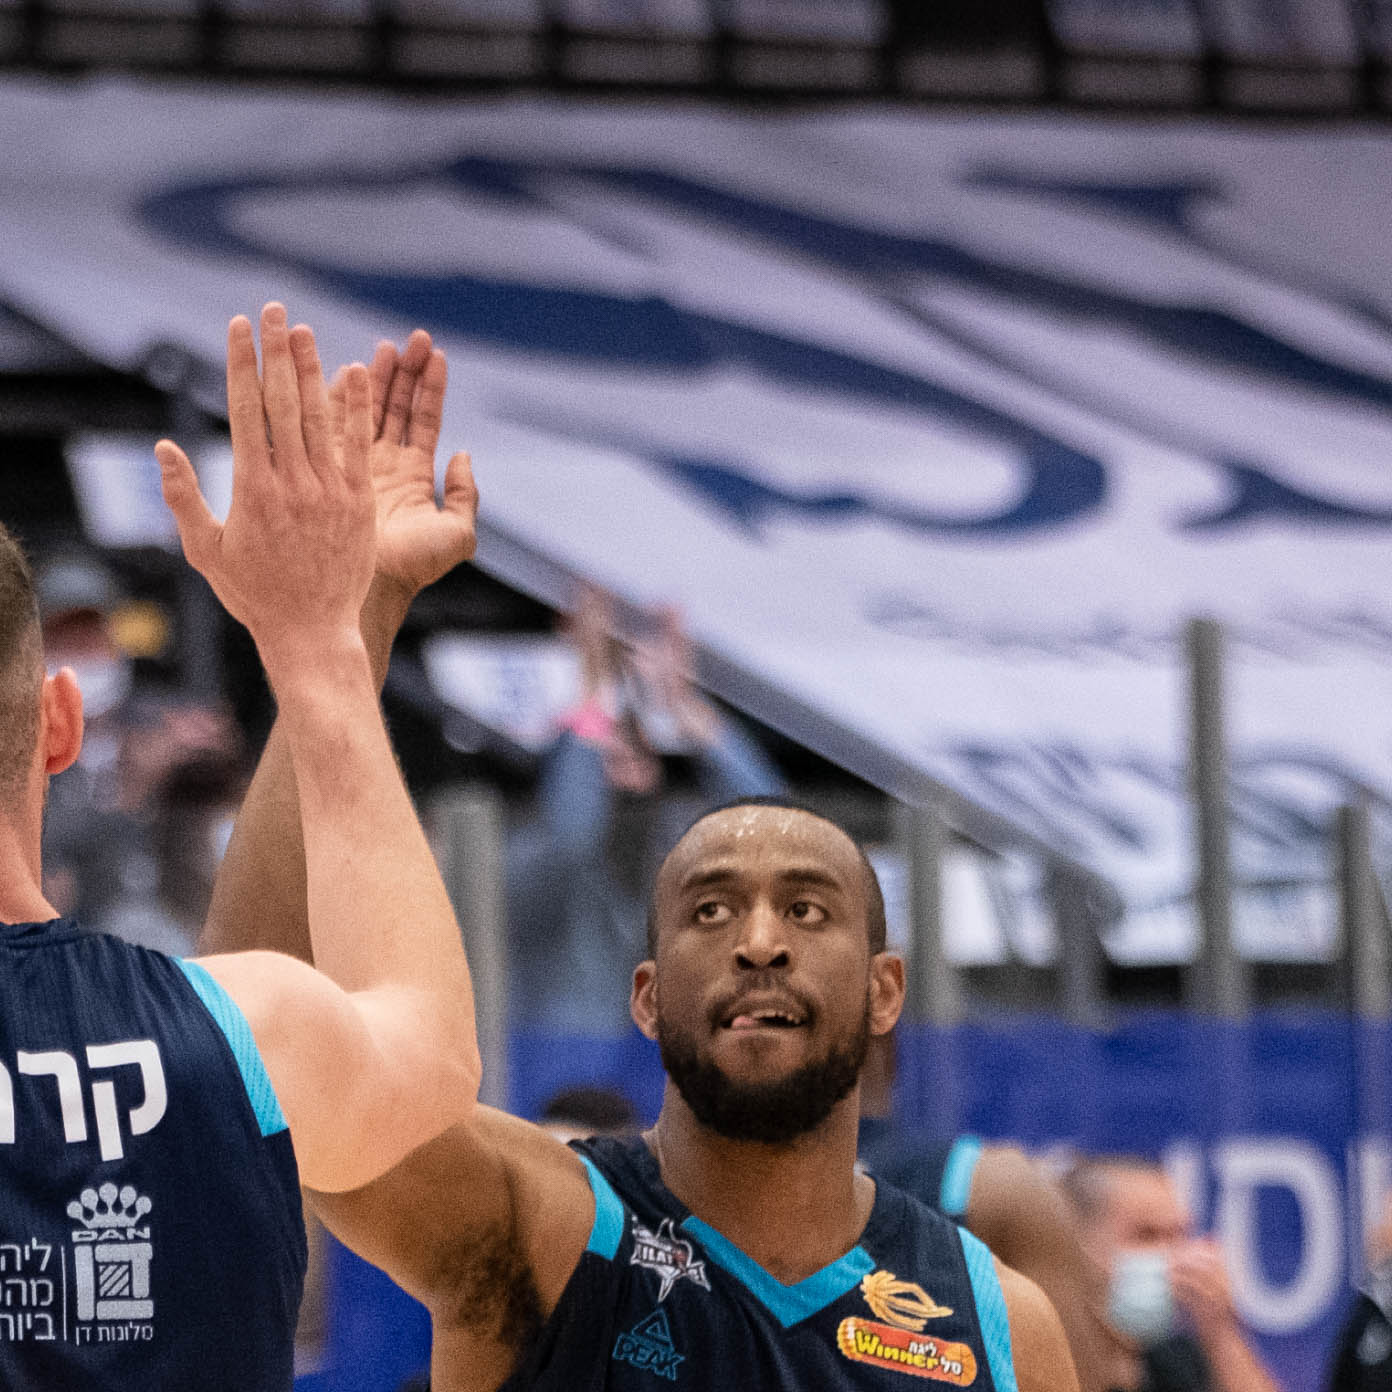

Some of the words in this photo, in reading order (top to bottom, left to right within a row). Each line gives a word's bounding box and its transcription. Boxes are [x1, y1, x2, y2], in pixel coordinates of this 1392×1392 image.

[71, 1226, 150, 1242] DAN
[75, 1326, 92, 1346] דן
[854, 1329, 939, 1369] Winner
[940, 1356, 963, 1376] סל
[612, 1333, 685, 1381] PEAK
